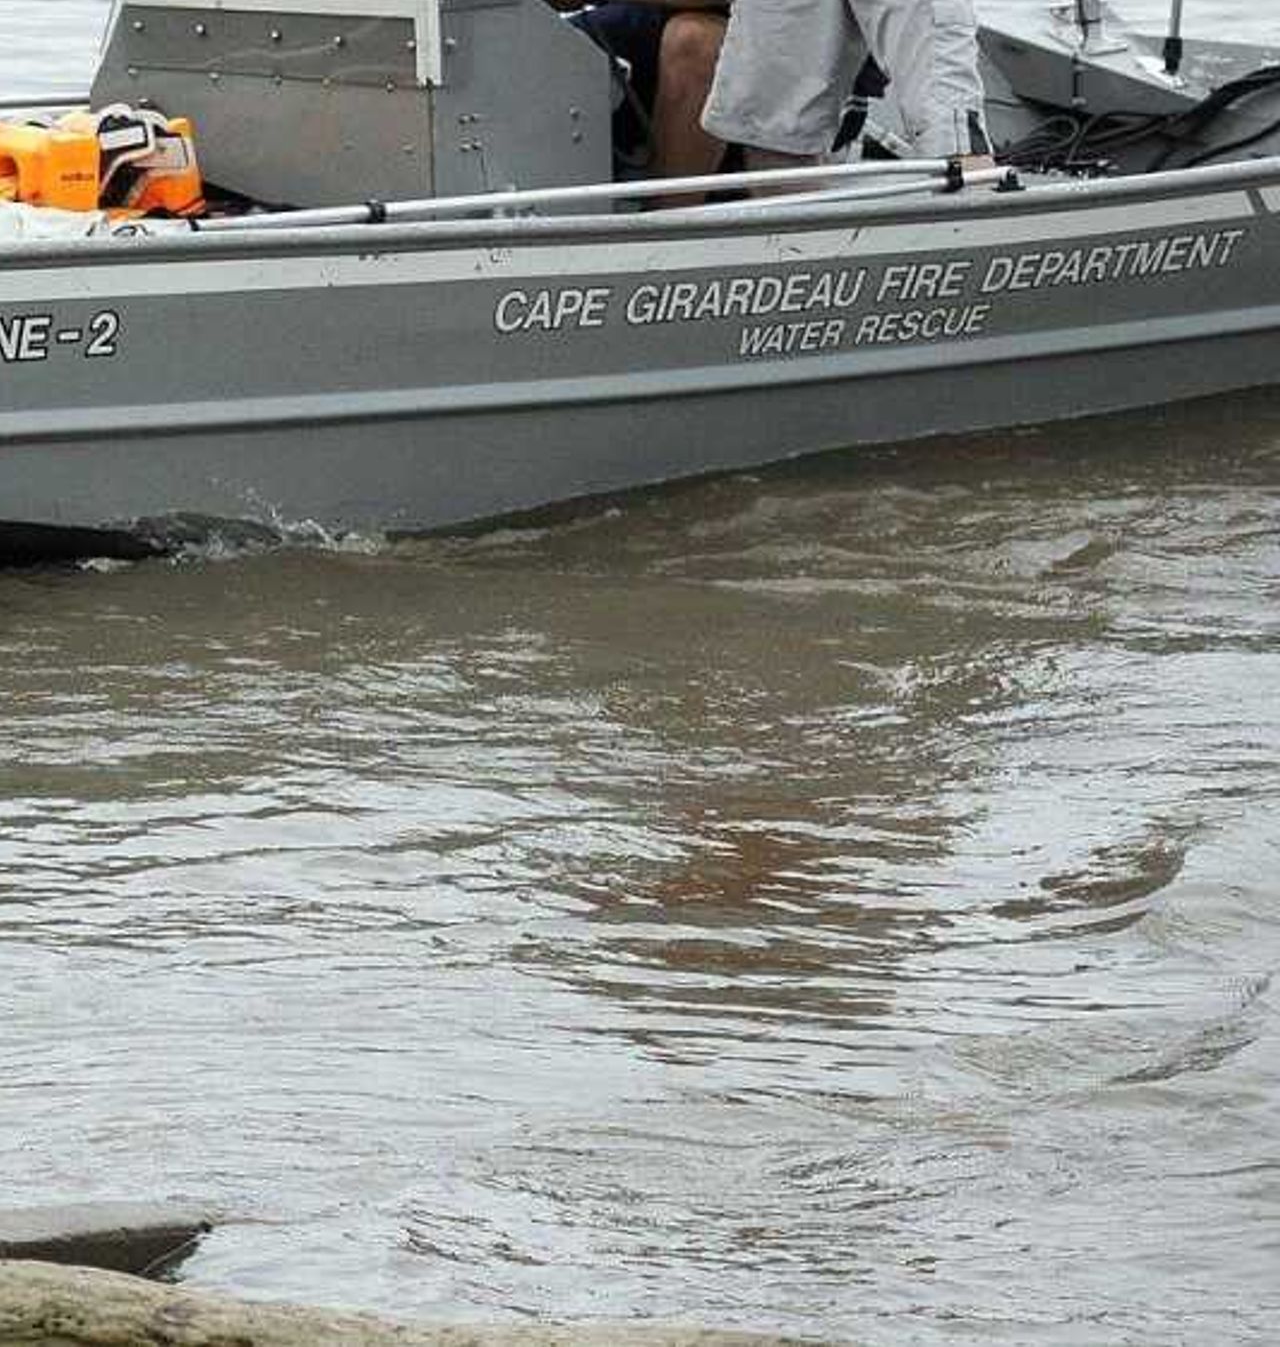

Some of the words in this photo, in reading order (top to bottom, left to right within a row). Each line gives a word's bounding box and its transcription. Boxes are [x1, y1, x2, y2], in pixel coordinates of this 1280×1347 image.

[494, 288, 610, 332] CAPE
[626, 269, 867, 325] GIRARDEAU
[877, 262, 972, 303] FIRE
[981, 230, 1244, 294] DEPARTMENT
[741, 321, 844, 355] WATER
[855, 305, 991, 346] RESCUE
